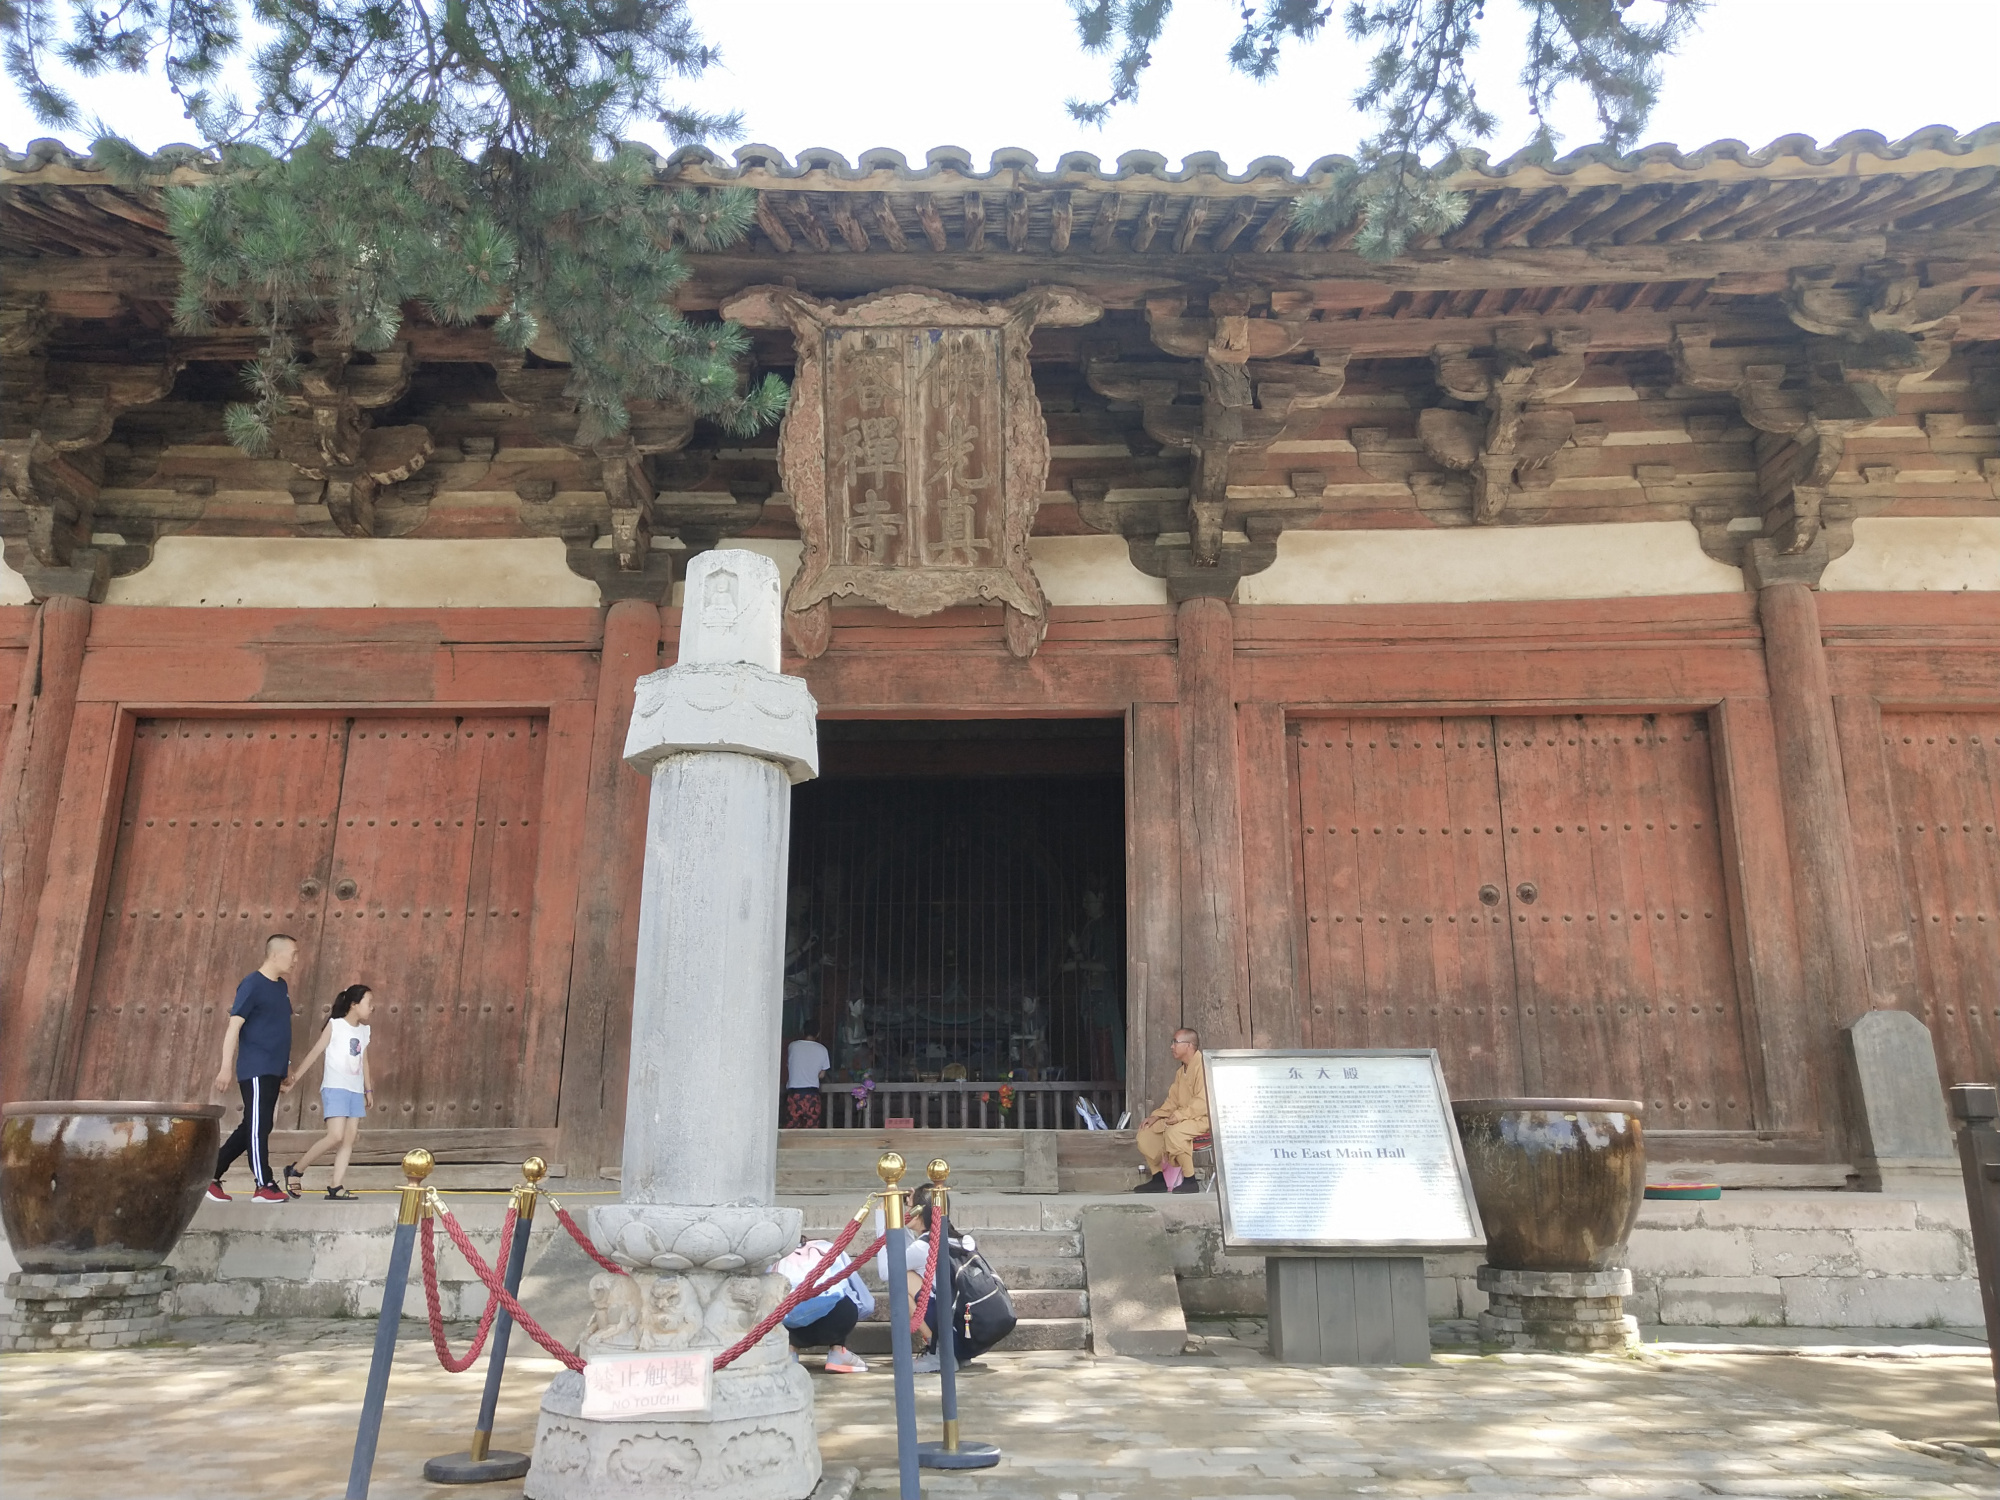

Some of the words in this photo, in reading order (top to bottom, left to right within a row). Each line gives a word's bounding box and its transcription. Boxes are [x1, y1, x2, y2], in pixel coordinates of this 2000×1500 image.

[1288, 1066, 1359, 1080] 东大殿
[1270, 1148, 1298, 1159] The
[1302, 1148, 1333, 1159] East
[1336, 1148, 1373, 1159] Main
[1376, 1147, 1406, 1159] Hall
[587, 1360, 699, 1393] 禁止触摸
[612, 1398, 631, 1410] NO
[634, 1394, 680, 1409] TOUCH!
